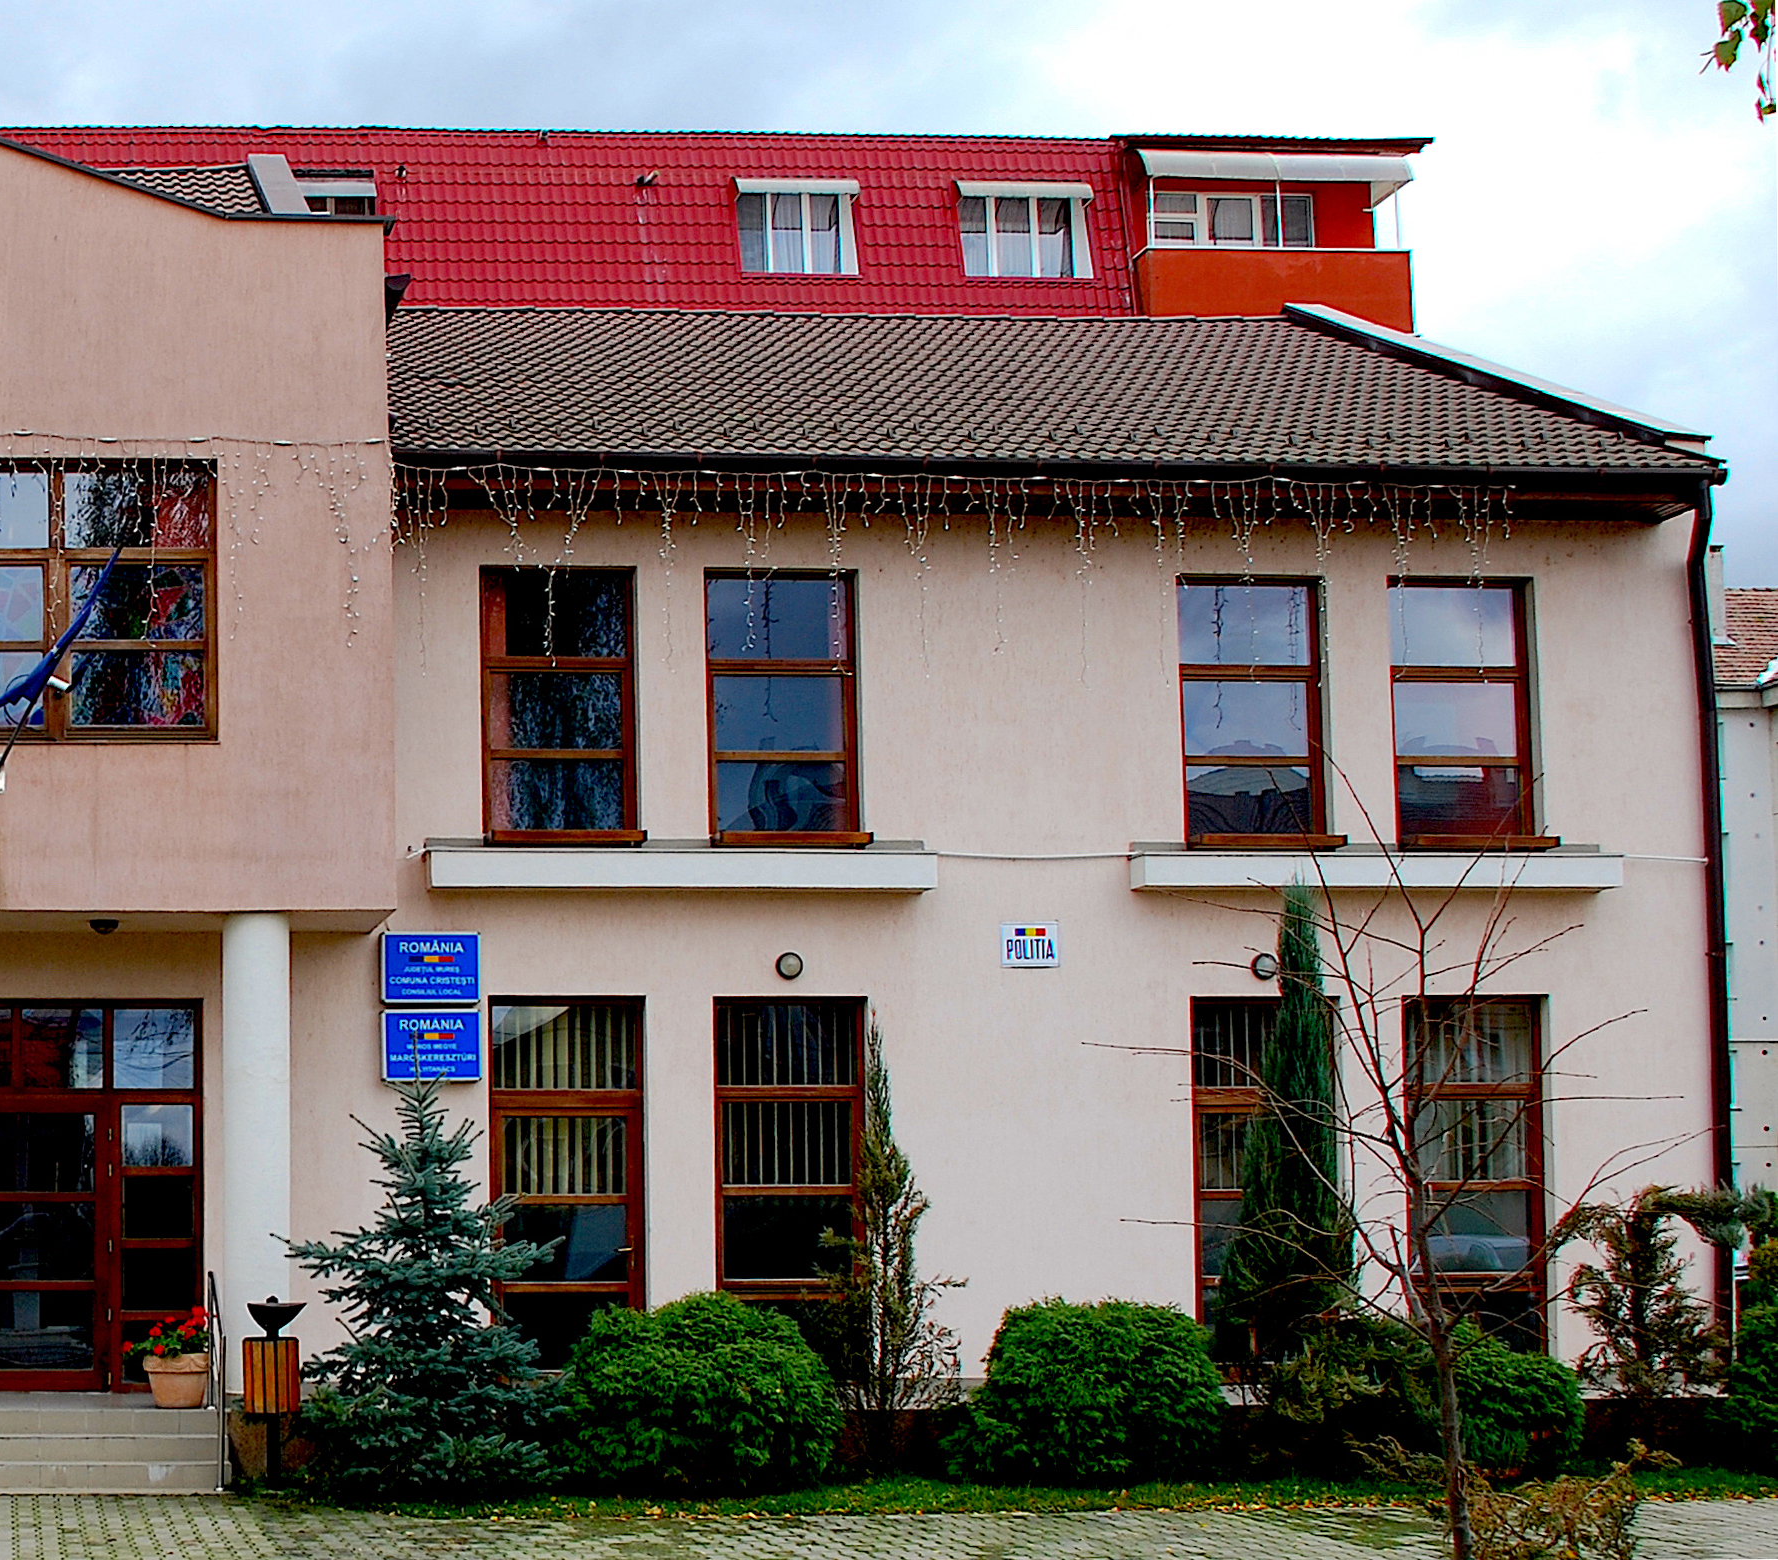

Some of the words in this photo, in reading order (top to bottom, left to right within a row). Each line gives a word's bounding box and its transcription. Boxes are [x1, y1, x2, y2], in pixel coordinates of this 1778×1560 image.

[399, 940, 464, 953] ROMÂNIA
[1006, 938, 1055, 960] POLITIA
[389, 976, 428, 985] COMUNA
[438, 988, 462, 996] LOCAL
